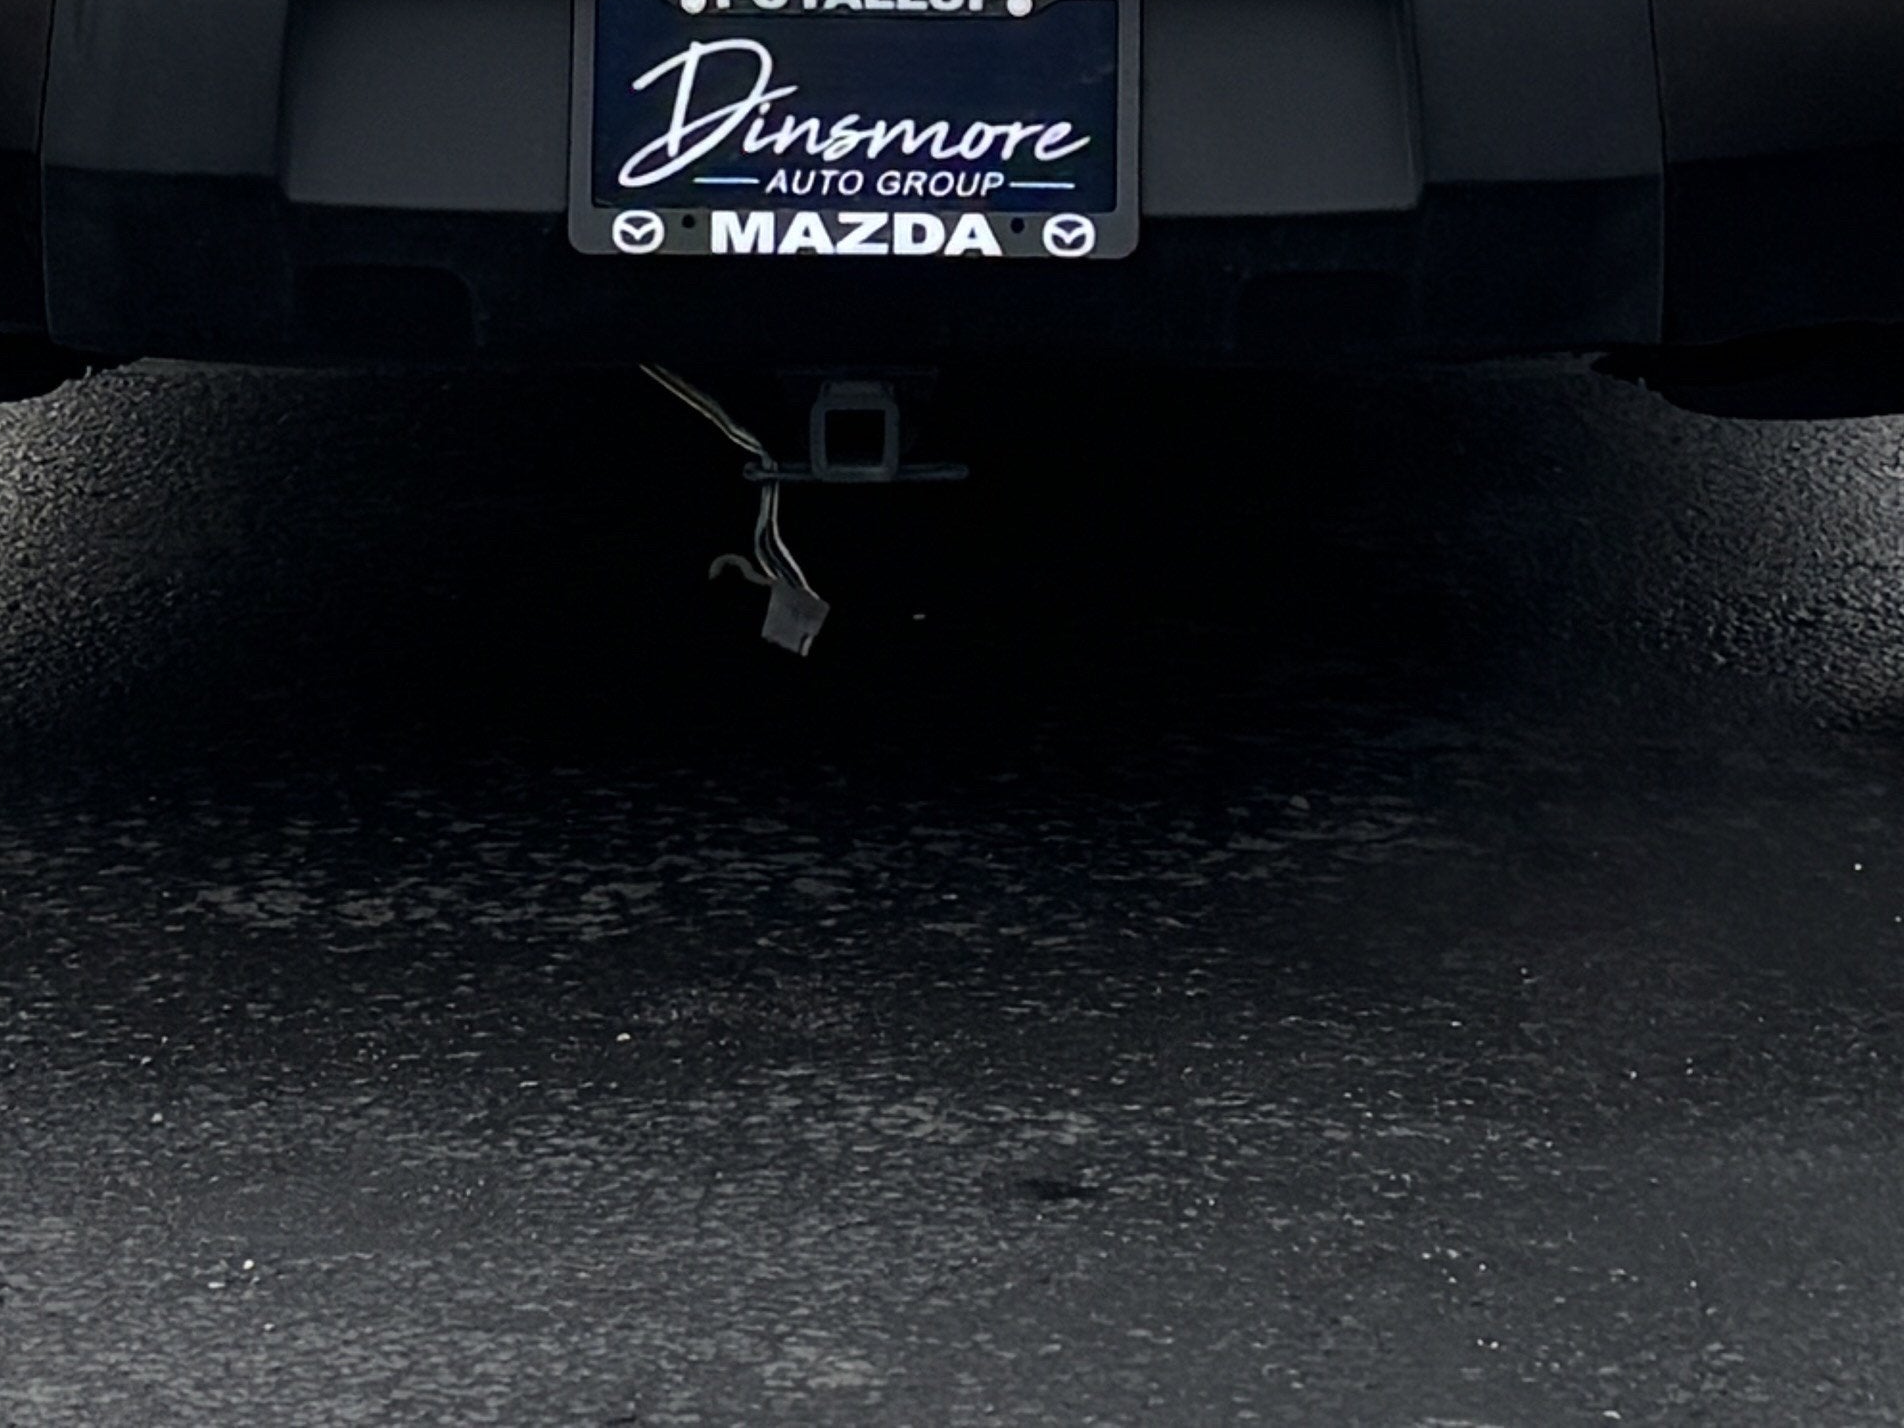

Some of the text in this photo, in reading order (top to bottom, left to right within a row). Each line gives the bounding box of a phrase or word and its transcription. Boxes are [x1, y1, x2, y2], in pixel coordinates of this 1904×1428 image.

[617, 38, 1092, 187] Dinsmore
[765, 169, 1005, 197] AUTO GROUP
[710, 210, 1003, 257] MAZDA
